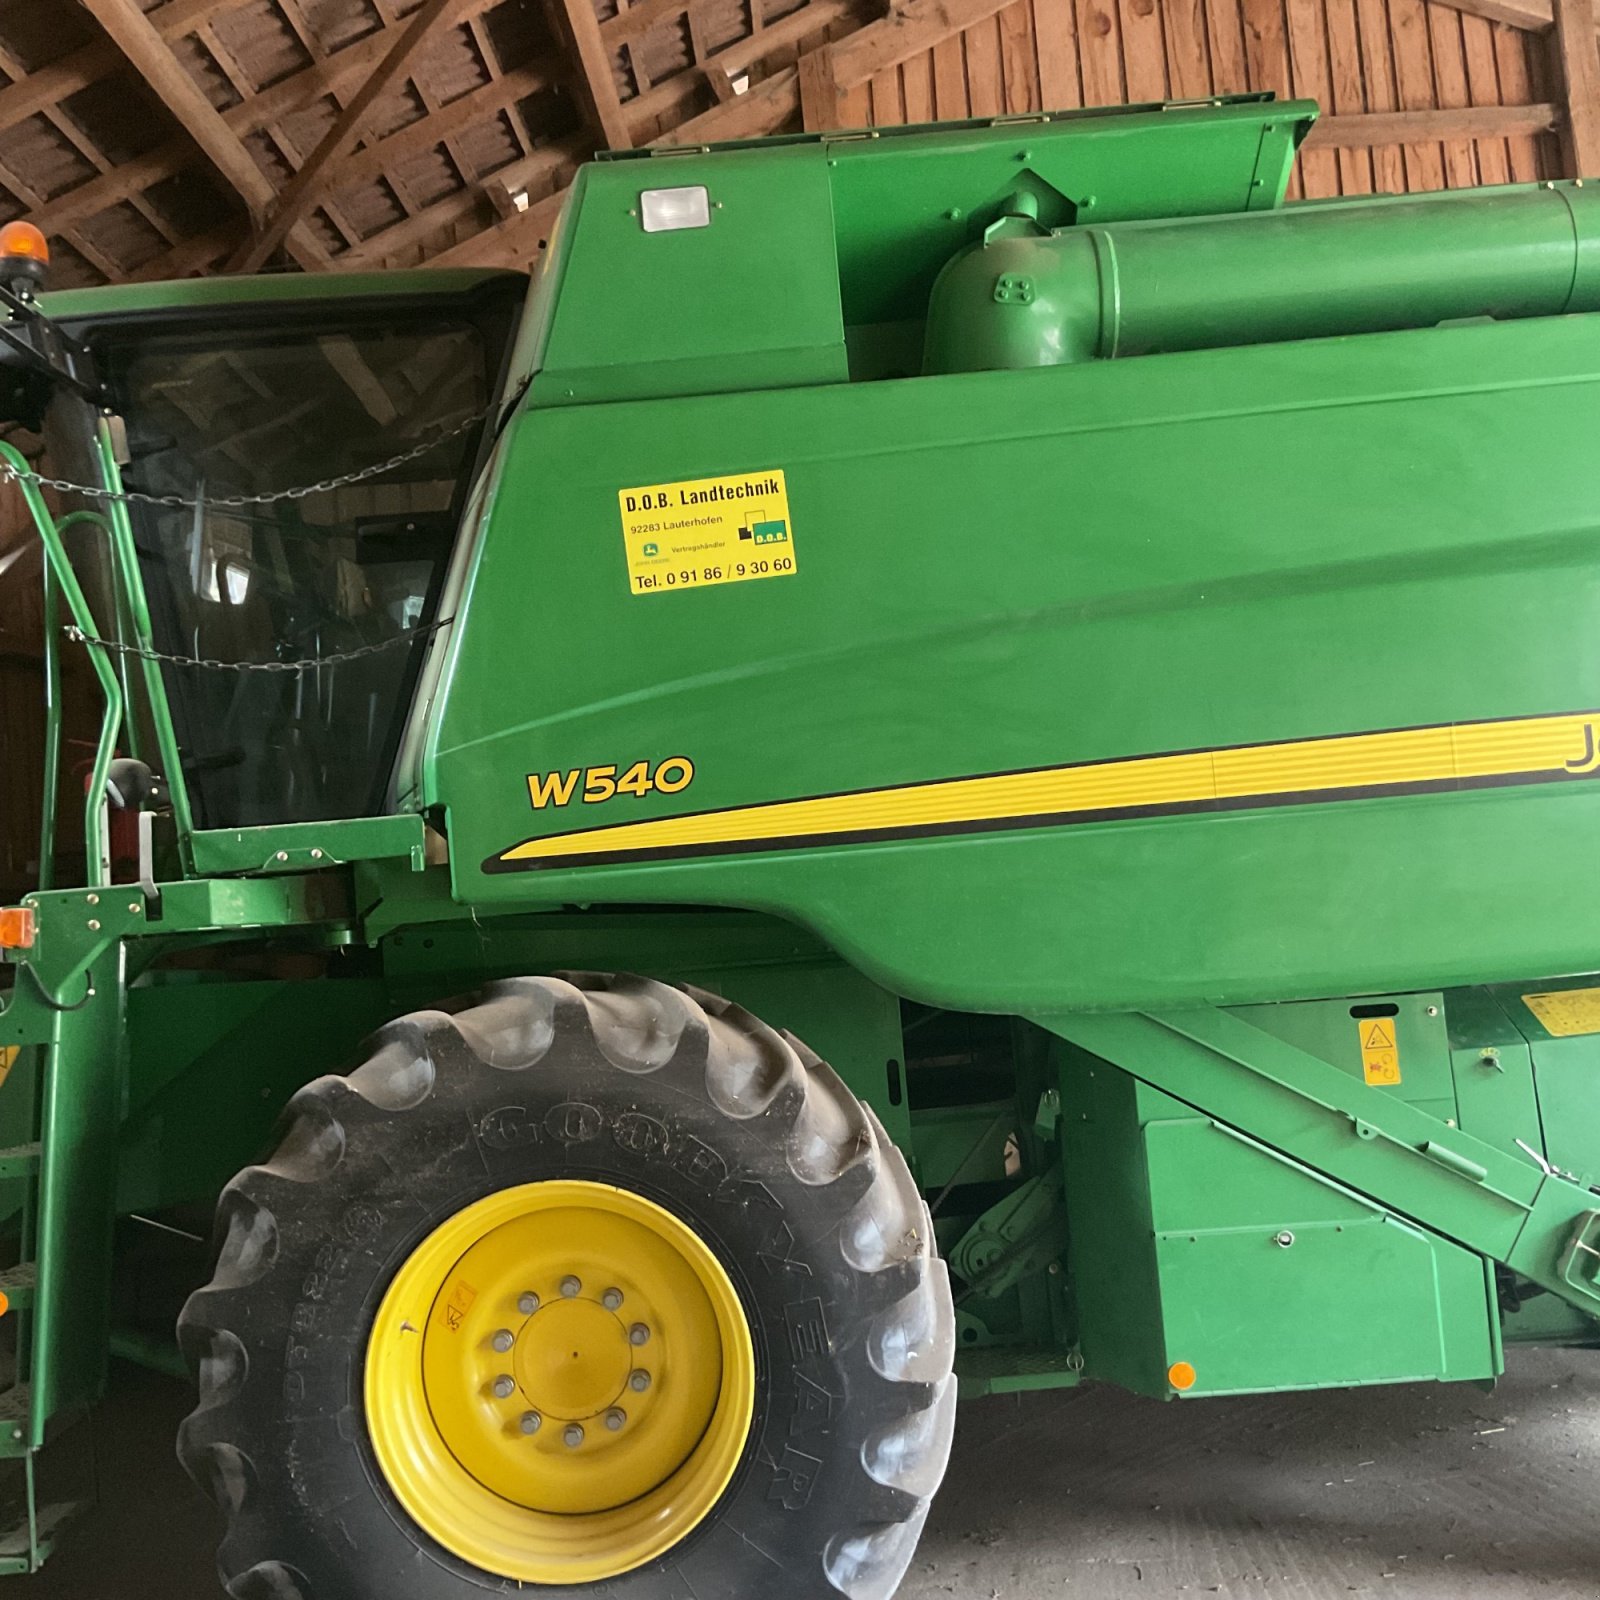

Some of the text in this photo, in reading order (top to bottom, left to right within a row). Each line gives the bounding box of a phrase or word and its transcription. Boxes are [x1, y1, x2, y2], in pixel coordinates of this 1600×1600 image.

[626, 478, 780, 512] D.O.B. Landtechnik
[630, 515, 723, 535] 92283 Lauterhofen
[756, 532, 787, 544] D.O.B.
[635, 574, 662, 589] Tel.
[666, 572, 676, 586] 0
[680, 569, 697, 584] 91
[704, 566, 722, 581] 86
[736, 563, 745, 576] 9
[750, 560, 769, 574] 30
[773, 557, 792, 571] 60
[526, 755, 695, 810] W540
